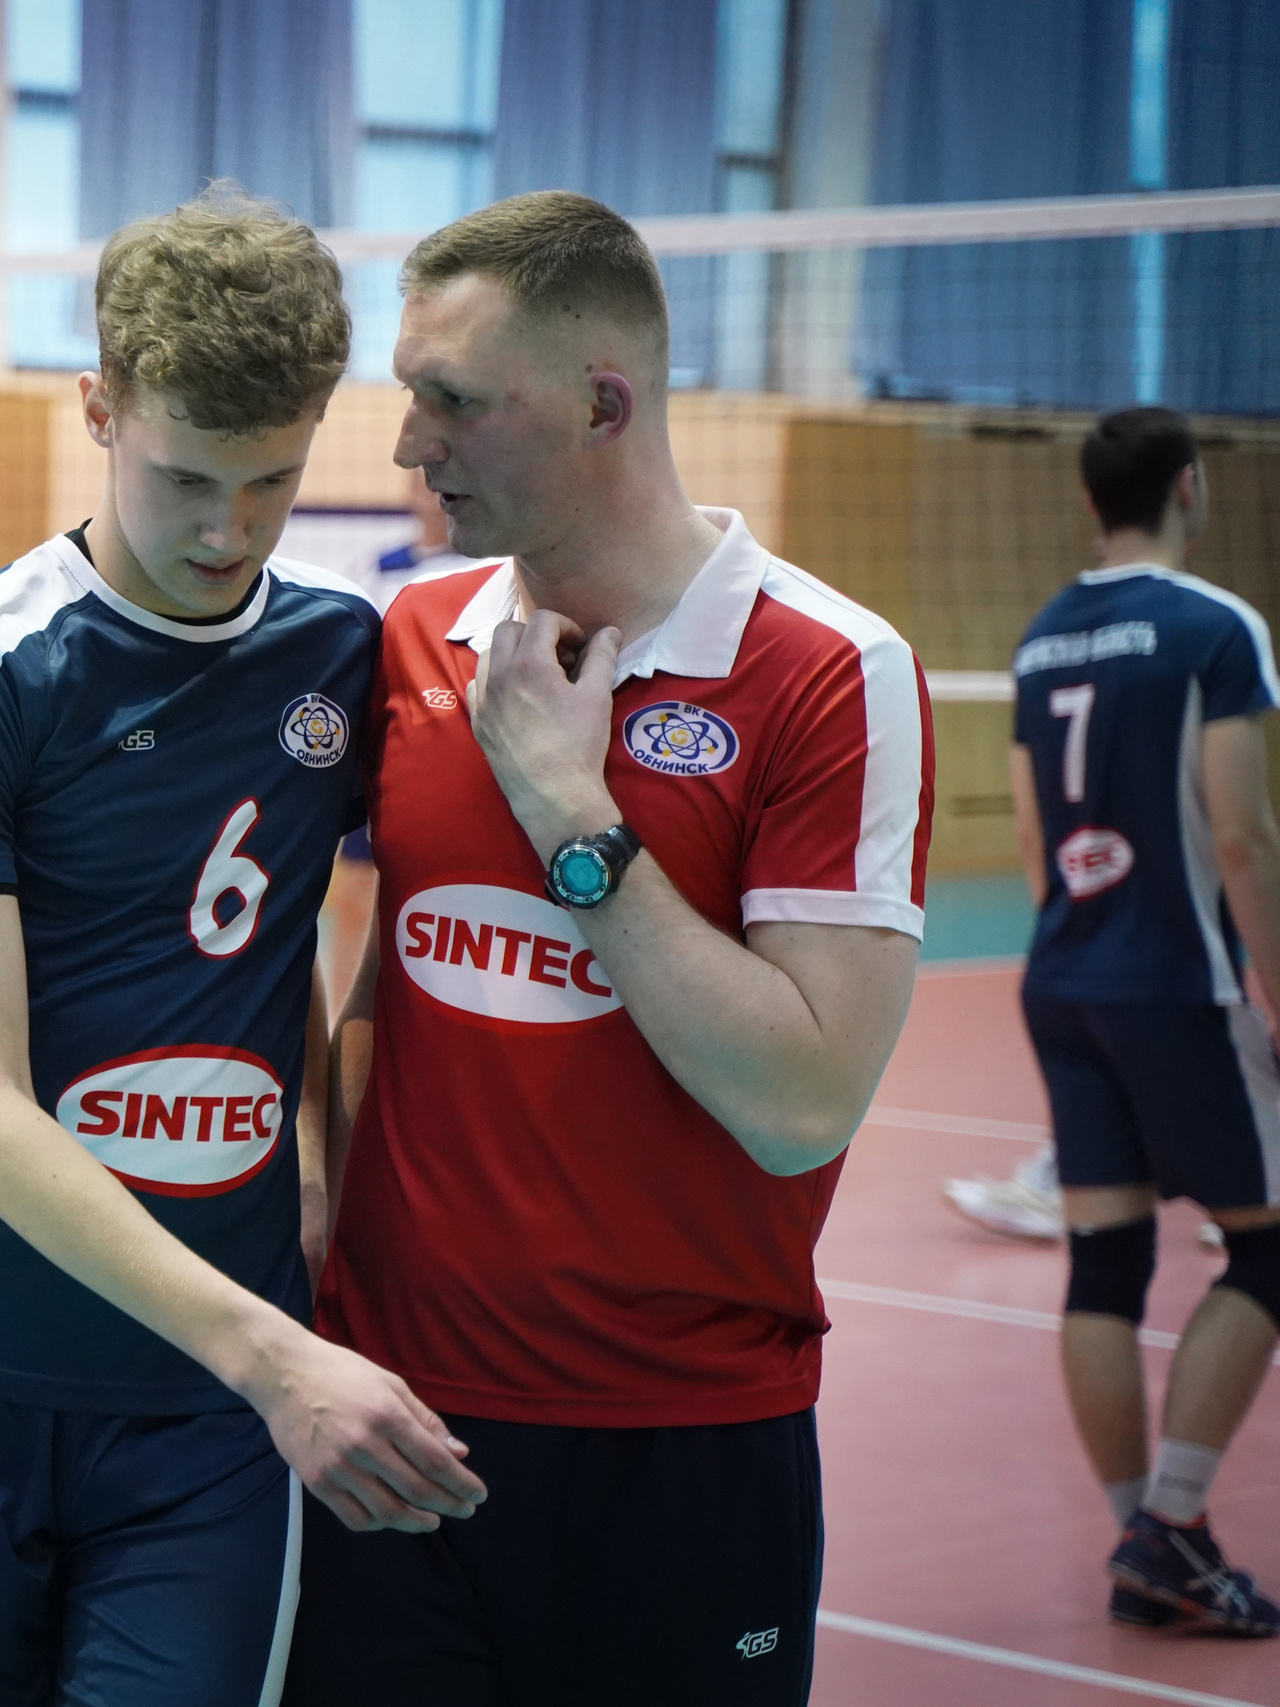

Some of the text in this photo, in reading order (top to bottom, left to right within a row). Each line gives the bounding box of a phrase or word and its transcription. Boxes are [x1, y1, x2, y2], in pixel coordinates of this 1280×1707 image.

[684, 704, 701, 716] ВК
[121, 730, 154, 751] GS
[1048, 683, 1095, 802] 7
[297, 748, 341, 765] ОБНИНСК
[633, 749, 709, 774] ОБНИНСК
[187, 797, 271, 959] 6
[405, 911, 612, 998] SINTEC
[77, 1091, 276, 1142] SINTEC
[746, 1627, 779, 1658] GS
